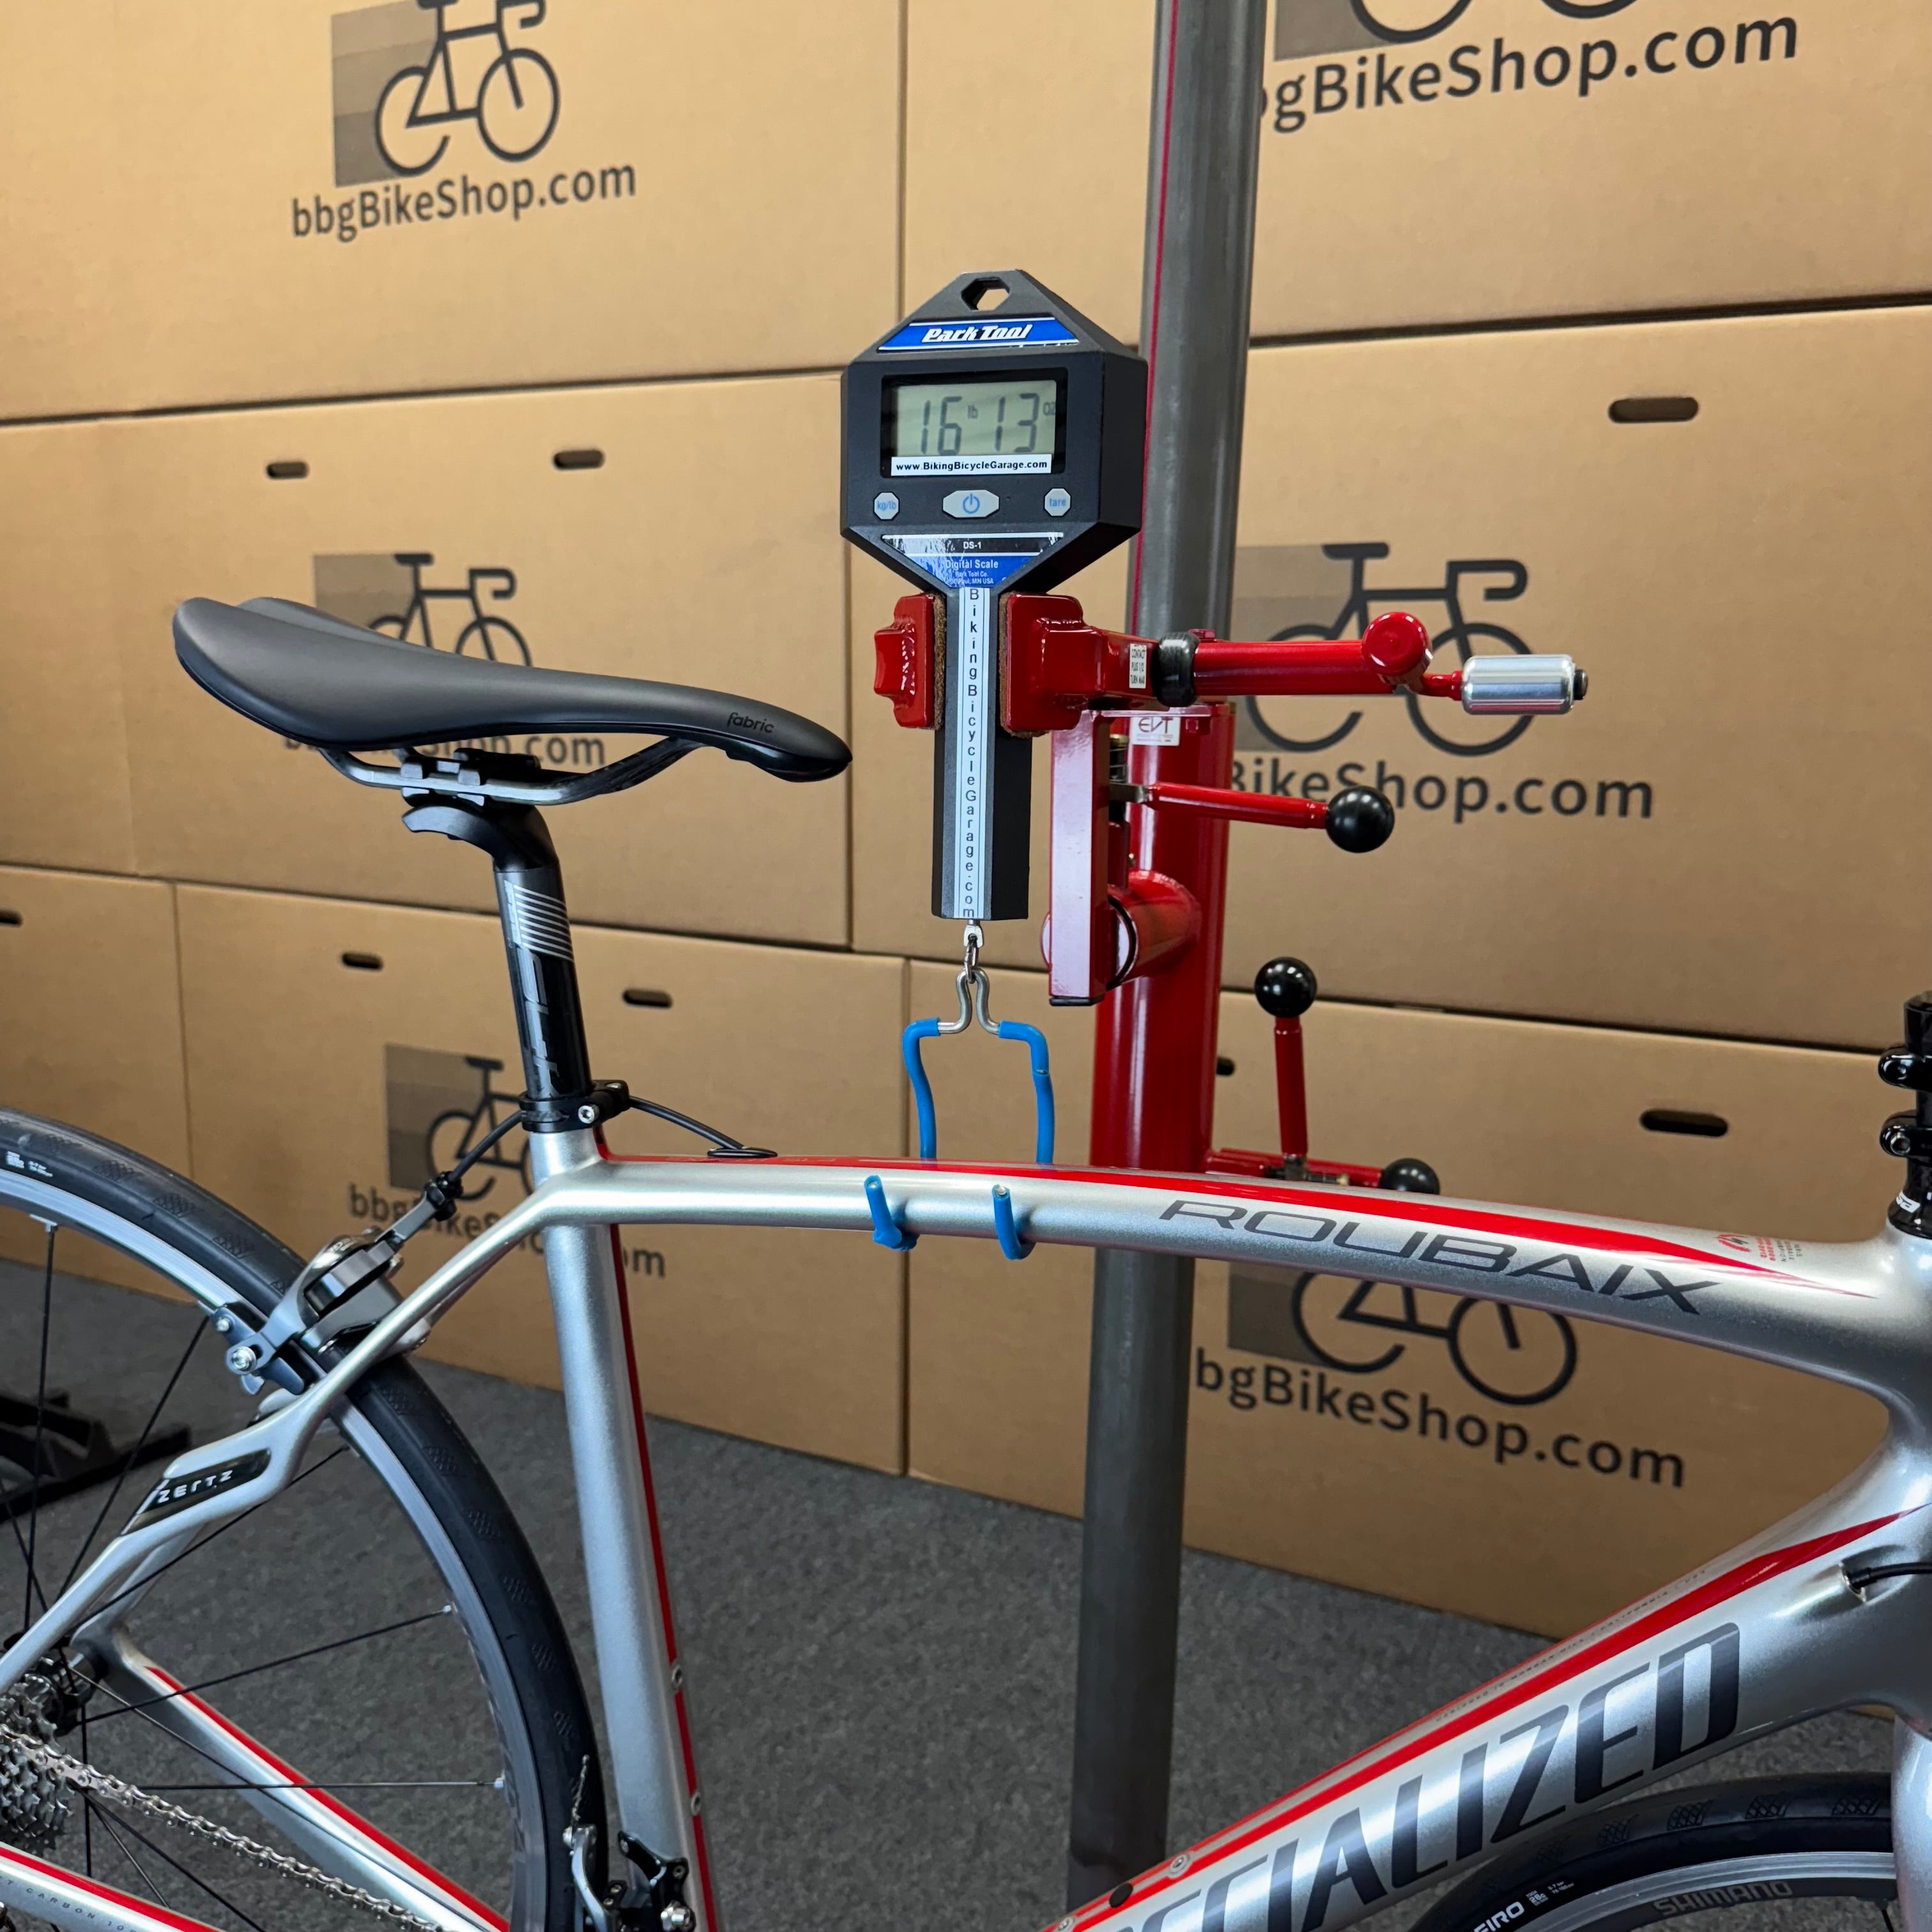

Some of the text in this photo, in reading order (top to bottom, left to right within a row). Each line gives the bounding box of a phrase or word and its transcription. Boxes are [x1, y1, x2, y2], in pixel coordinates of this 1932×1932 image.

[1260, 15, 1798, 133] gBikeShop.com
[291, 164, 636, 243] bbgBikeShop.com
[921, 324, 1033, 343] Park Tool
[921, 396, 963, 456] 16
[995, 393, 1040, 454] 13
[896, 461, 1048, 472] www.BikingBicycleGarage.com
[877, 501, 898, 511] kg/lb
[1048, 498, 1067, 508] tare
[963, 541, 982, 549] DS-1
[945, 559, 999, 571] Digital Scale
[727, 712, 774, 733] fabric
[1159, 1199, 1721, 1315] ROUBAIX
[1196, 1347, 1685, 1489] bgBikeShop.com
[26, 1887, 96, 1919] CARBON
[1653, 1881, 1793, 1915] SHIMANO
